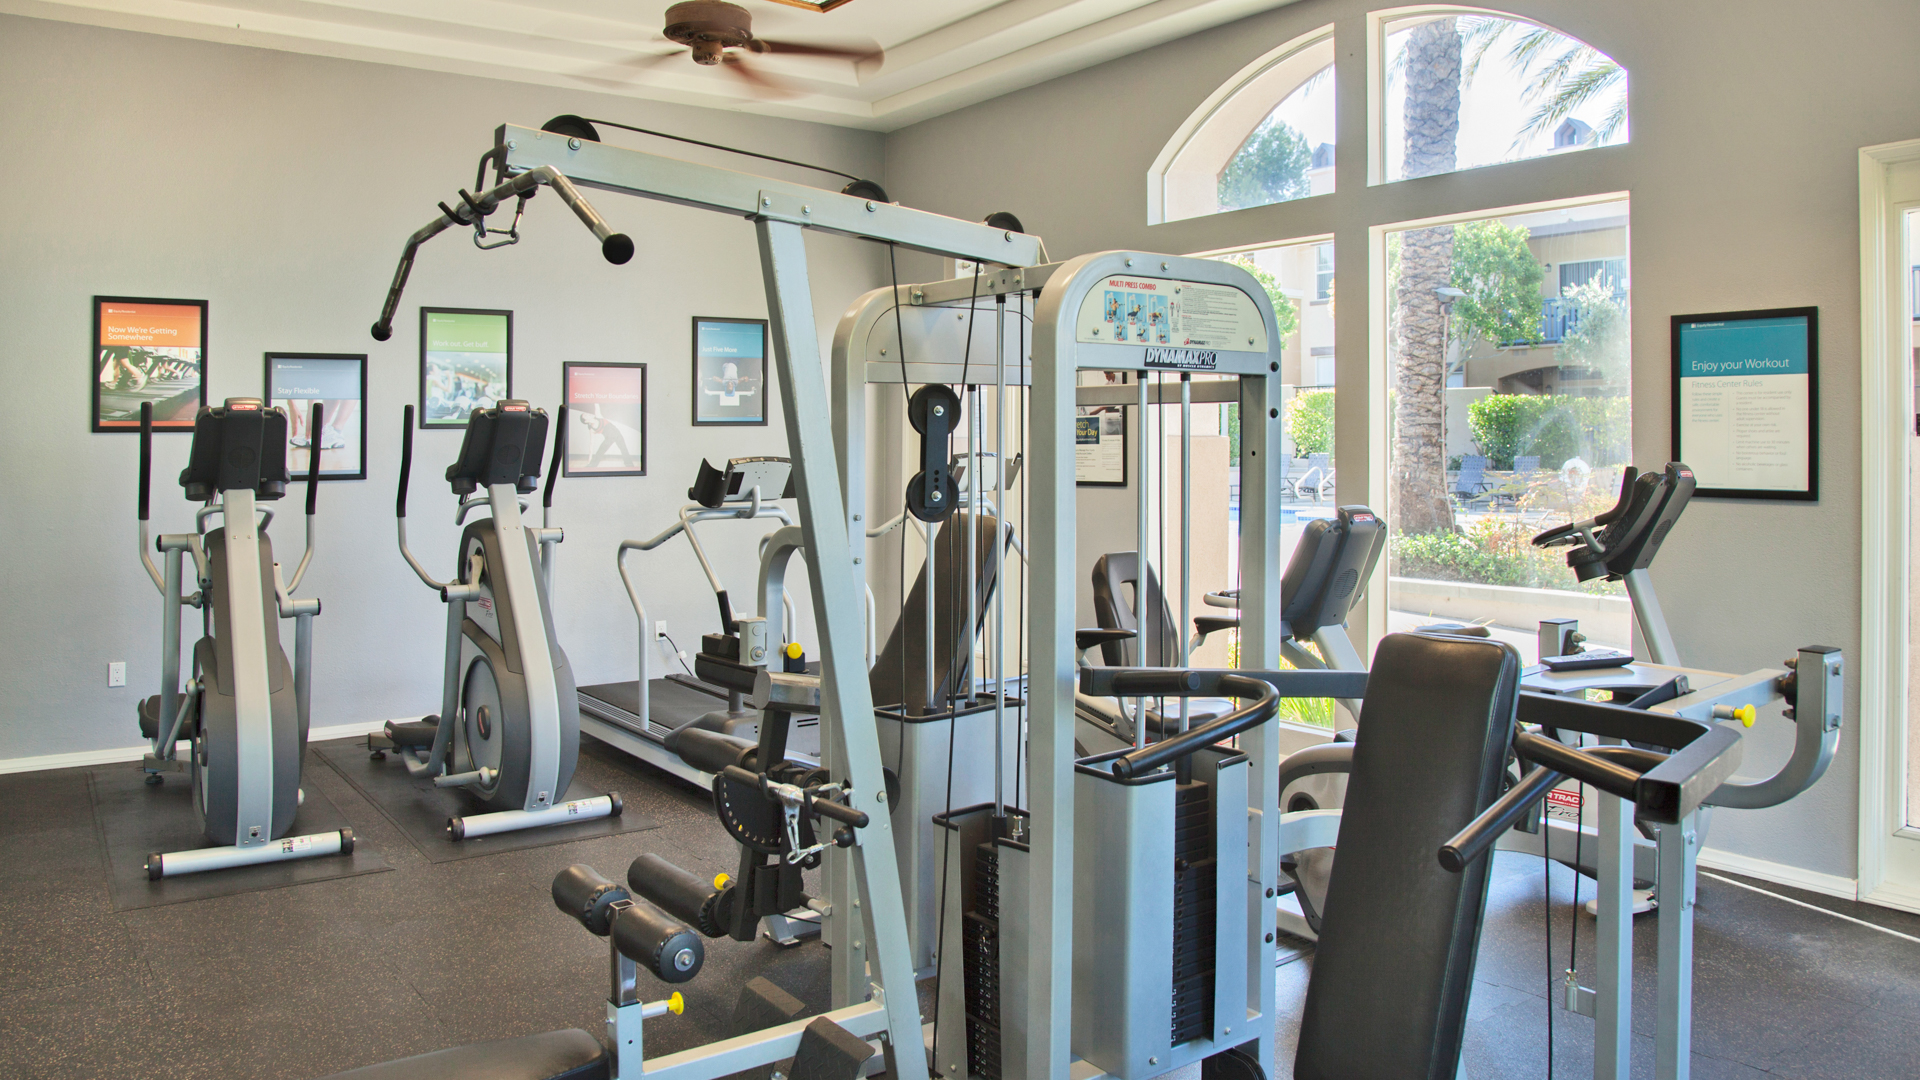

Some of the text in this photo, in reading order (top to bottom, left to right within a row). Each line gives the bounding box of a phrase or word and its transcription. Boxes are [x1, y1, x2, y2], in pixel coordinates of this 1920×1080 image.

[149, 327, 177, 336] Getting
[1146, 348, 1218, 365] DYNAMAXPRO
[1692, 358, 1789, 372] Enjoy your Workout
[278, 387, 292, 395] Stay
[1088, 429, 1098, 437] Day
[1554, 793, 1579, 803] TRAC
[1547, 806, 1579, 817] Pro
